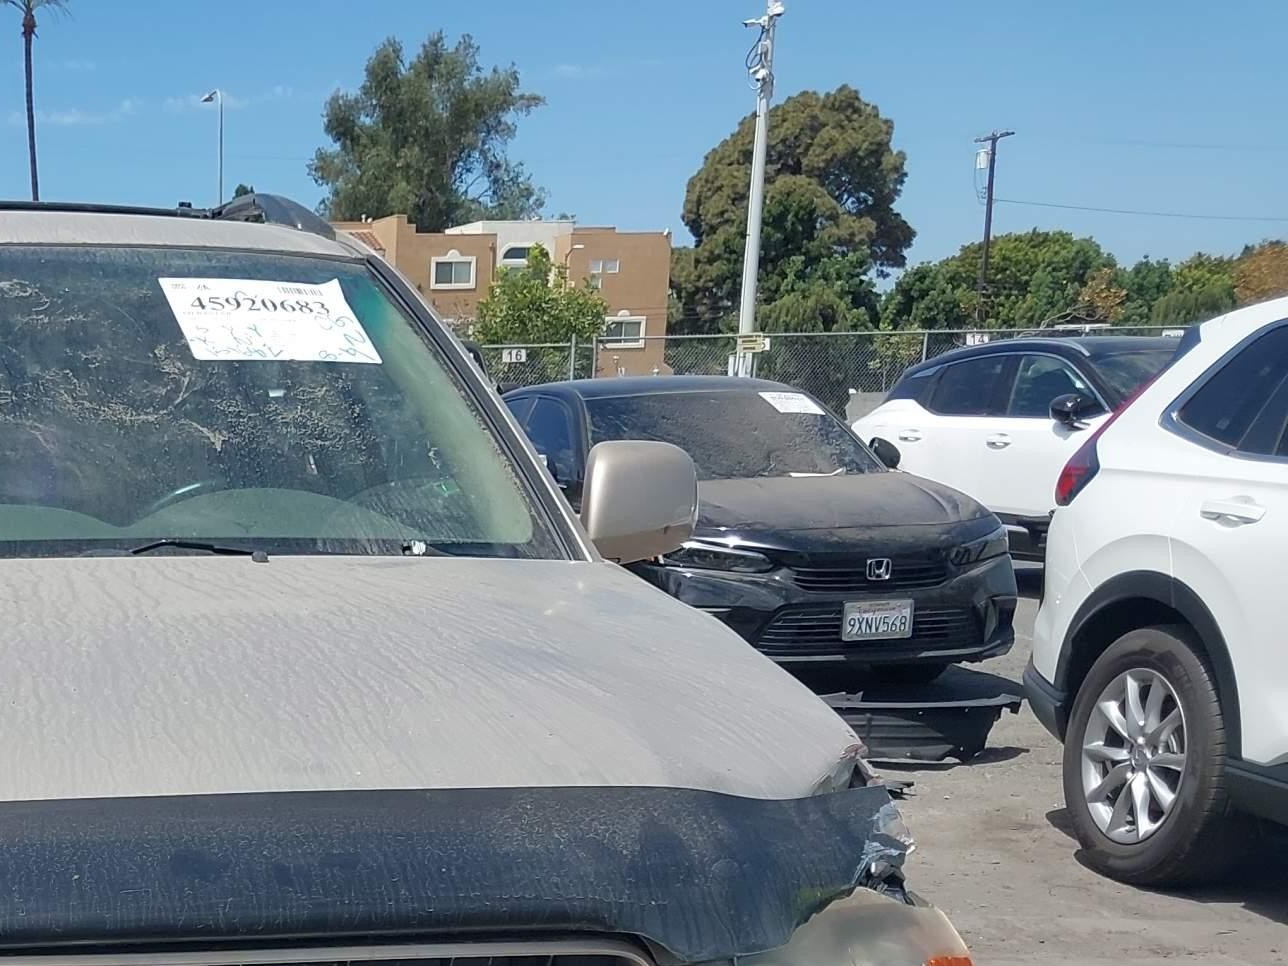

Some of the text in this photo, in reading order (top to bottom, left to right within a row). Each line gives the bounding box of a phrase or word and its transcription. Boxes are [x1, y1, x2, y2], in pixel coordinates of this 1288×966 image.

[190, 296, 330, 315] 45920683
[506, 350, 522, 362] 16
[847, 615, 908, 634] 9XNV568
